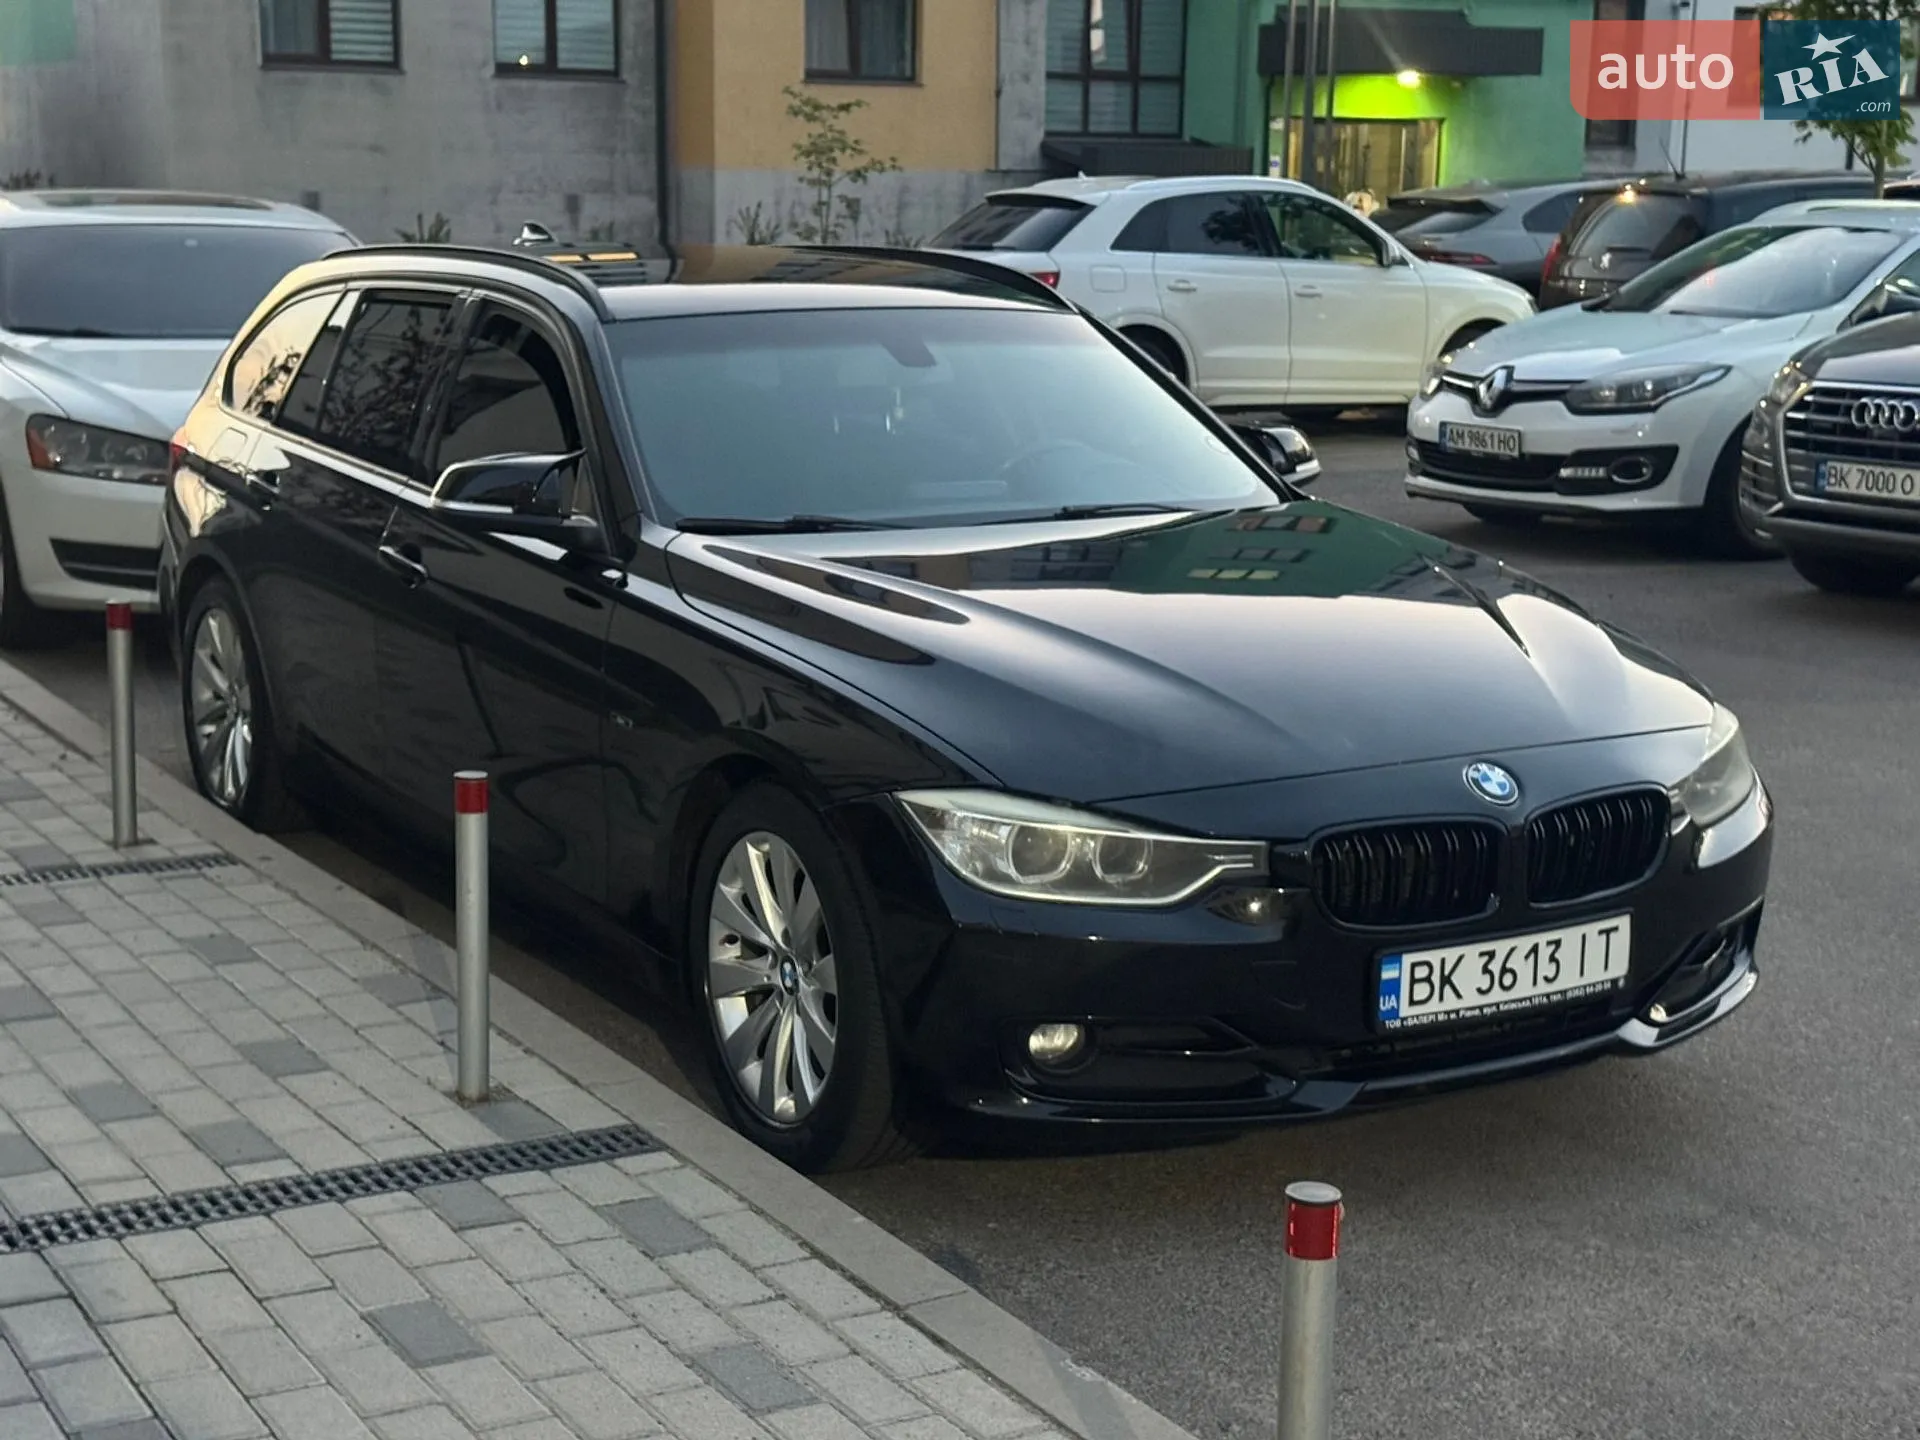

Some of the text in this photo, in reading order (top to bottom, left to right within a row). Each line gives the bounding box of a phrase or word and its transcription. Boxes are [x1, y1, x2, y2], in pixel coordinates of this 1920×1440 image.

[1448, 427, 1465, 446] AM
[1497, 432, 1516, 452] HO
[1826, 465, 1853, 489] BK
[1855, 468, 1896, 492] 7000
[1407, 925, 1620, 1008] BK 3613 IT
[1379, 994, 1398, 1012] UA
